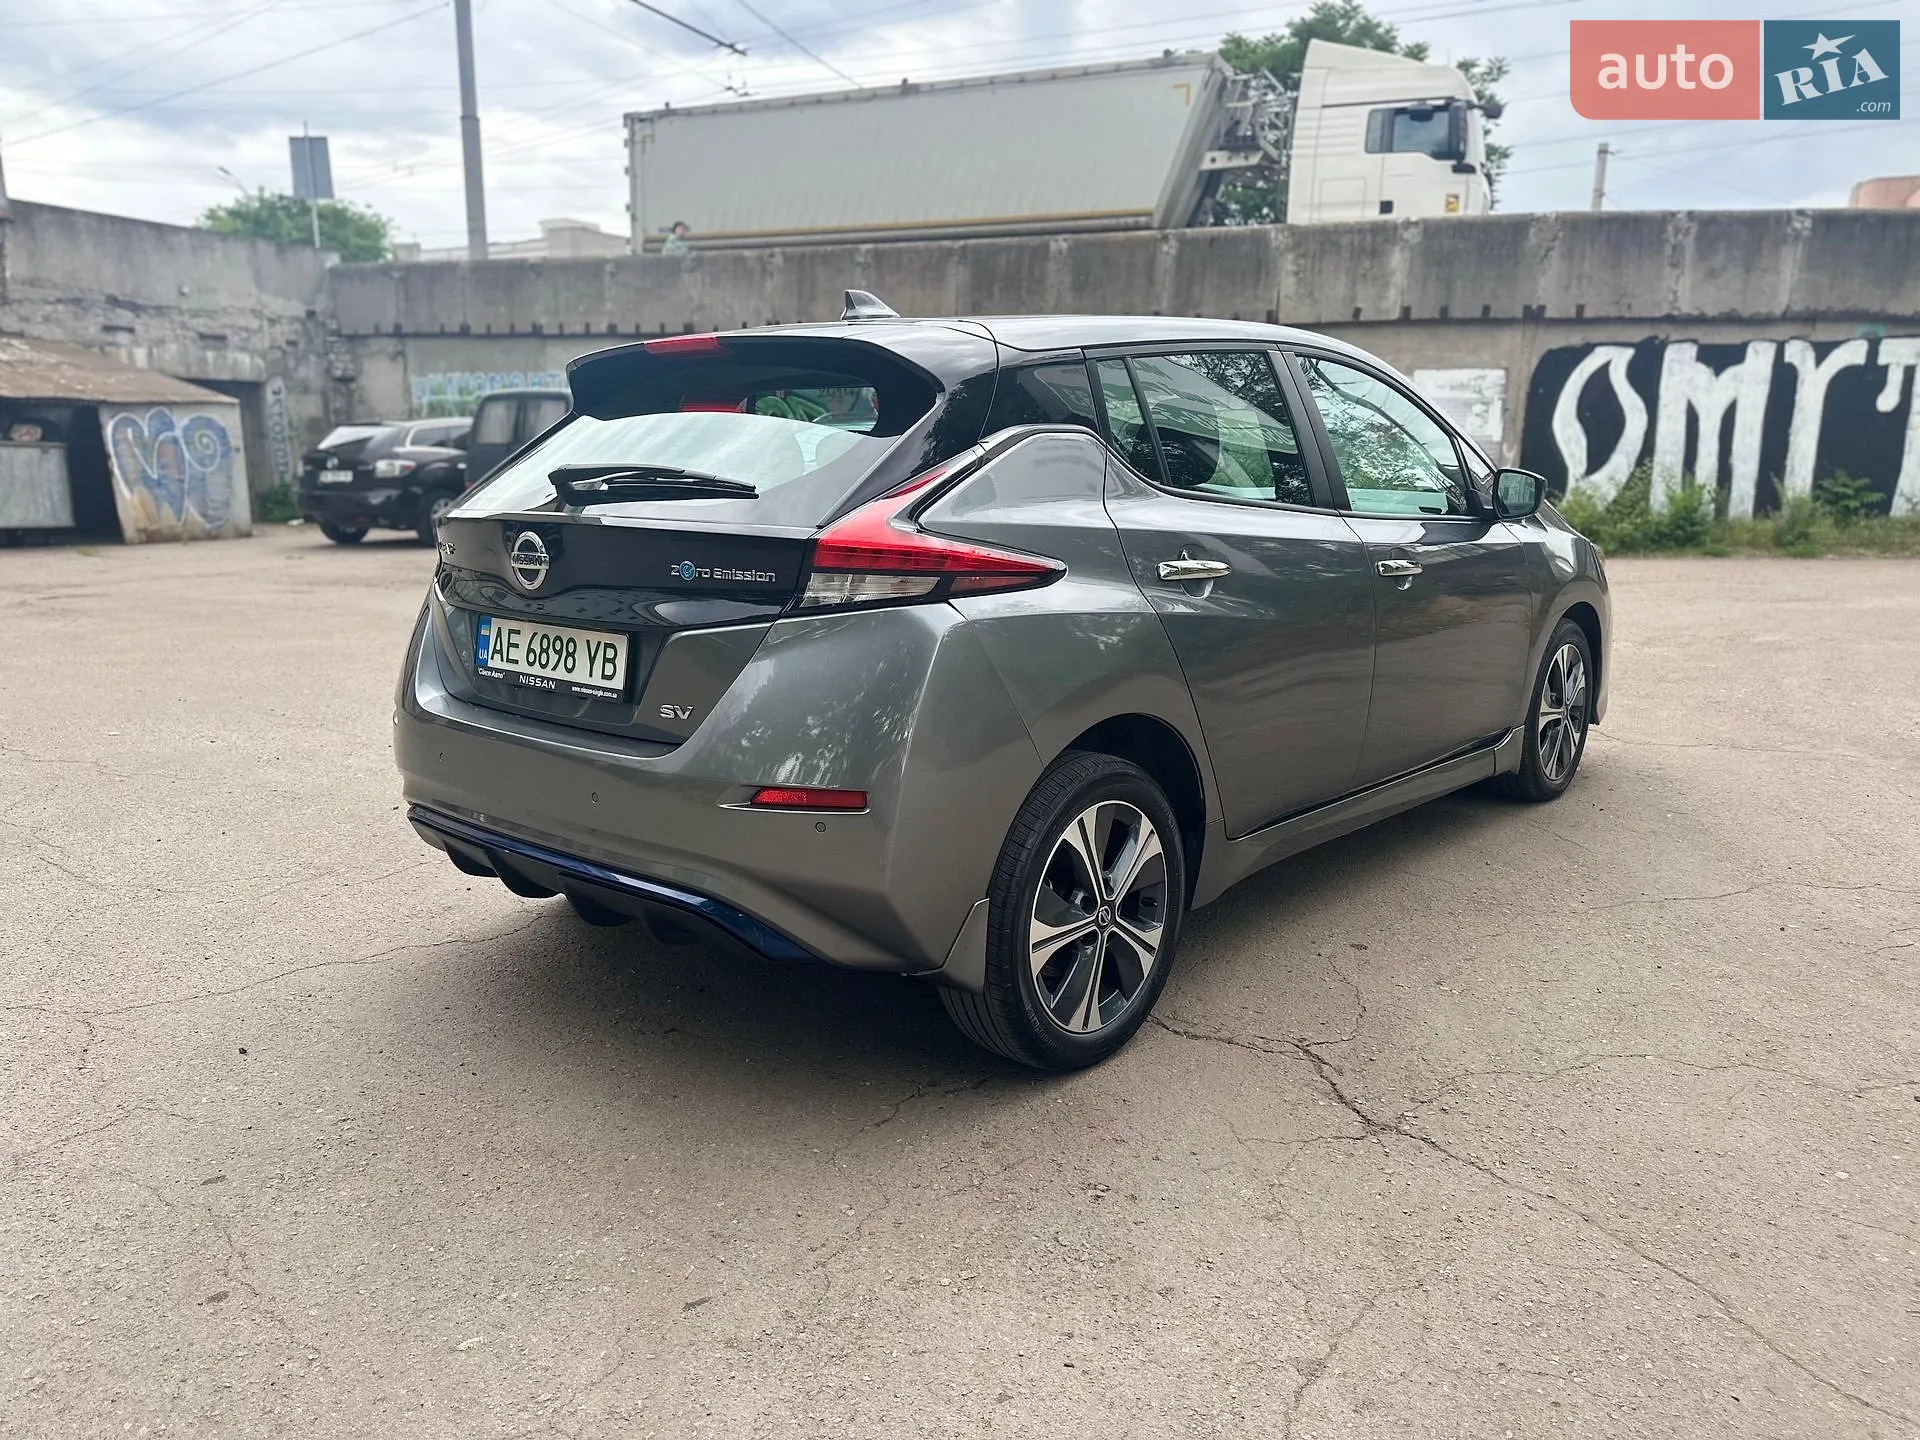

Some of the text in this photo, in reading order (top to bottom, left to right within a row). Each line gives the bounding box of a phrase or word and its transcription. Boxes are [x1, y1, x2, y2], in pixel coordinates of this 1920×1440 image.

[478, 648, 488, 660] UA
[490, 626, 618, 681] AE 6898 YB
[519, 674, 556, 690] NISSAN
[660, 704, 693, 720] SV
